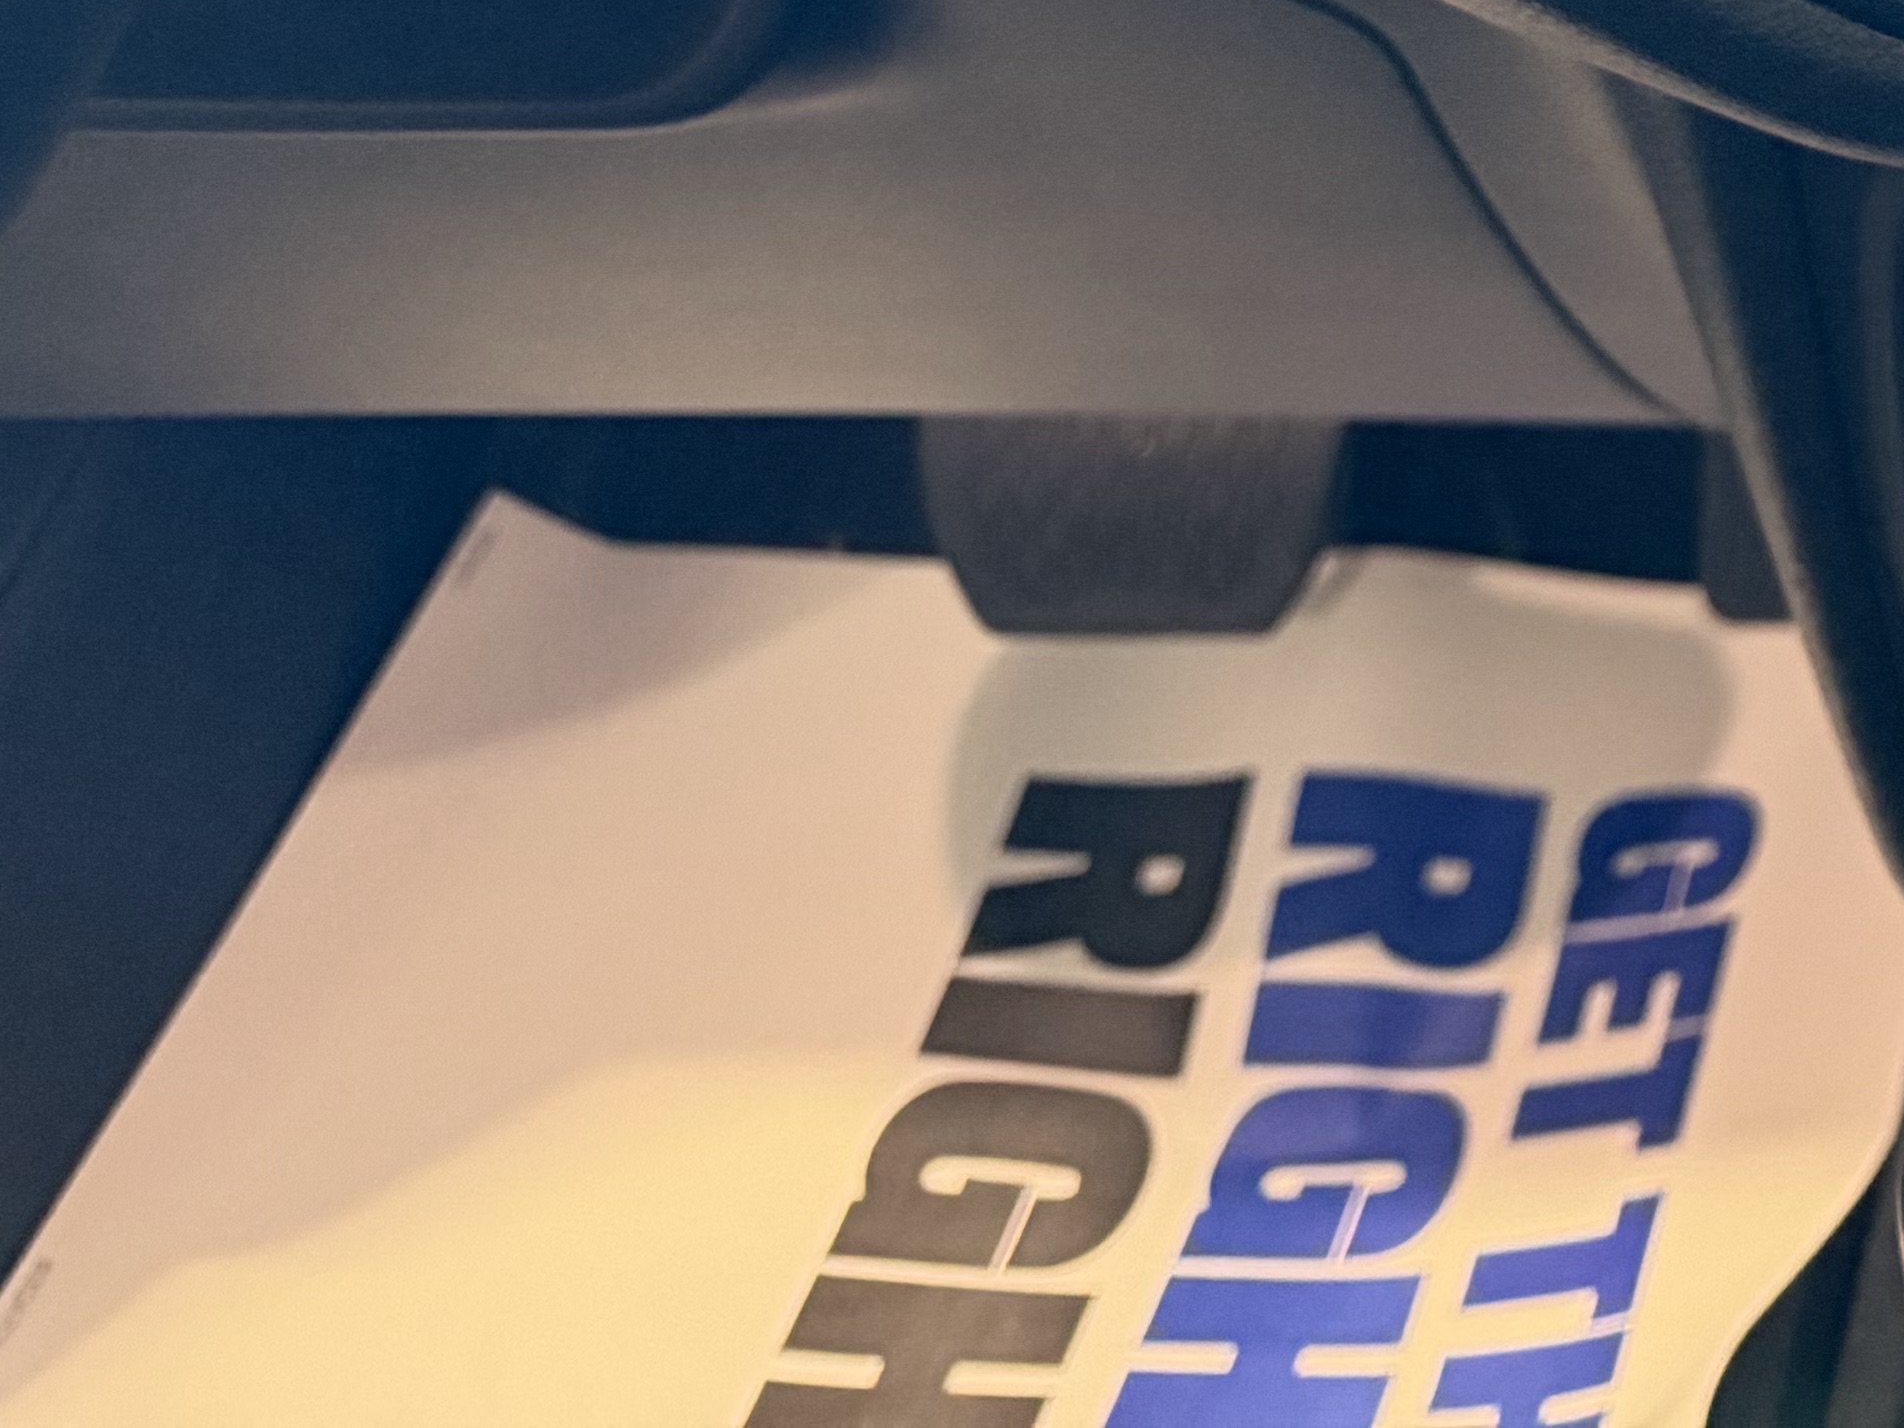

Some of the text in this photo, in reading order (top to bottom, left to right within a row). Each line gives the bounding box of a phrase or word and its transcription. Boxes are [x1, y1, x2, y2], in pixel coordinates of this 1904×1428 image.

[742, 774, 1252, 1428] RIGH
[1103, 768, 1550, 1428] RIGH
[1510, 786, 1762, 1154] GET
